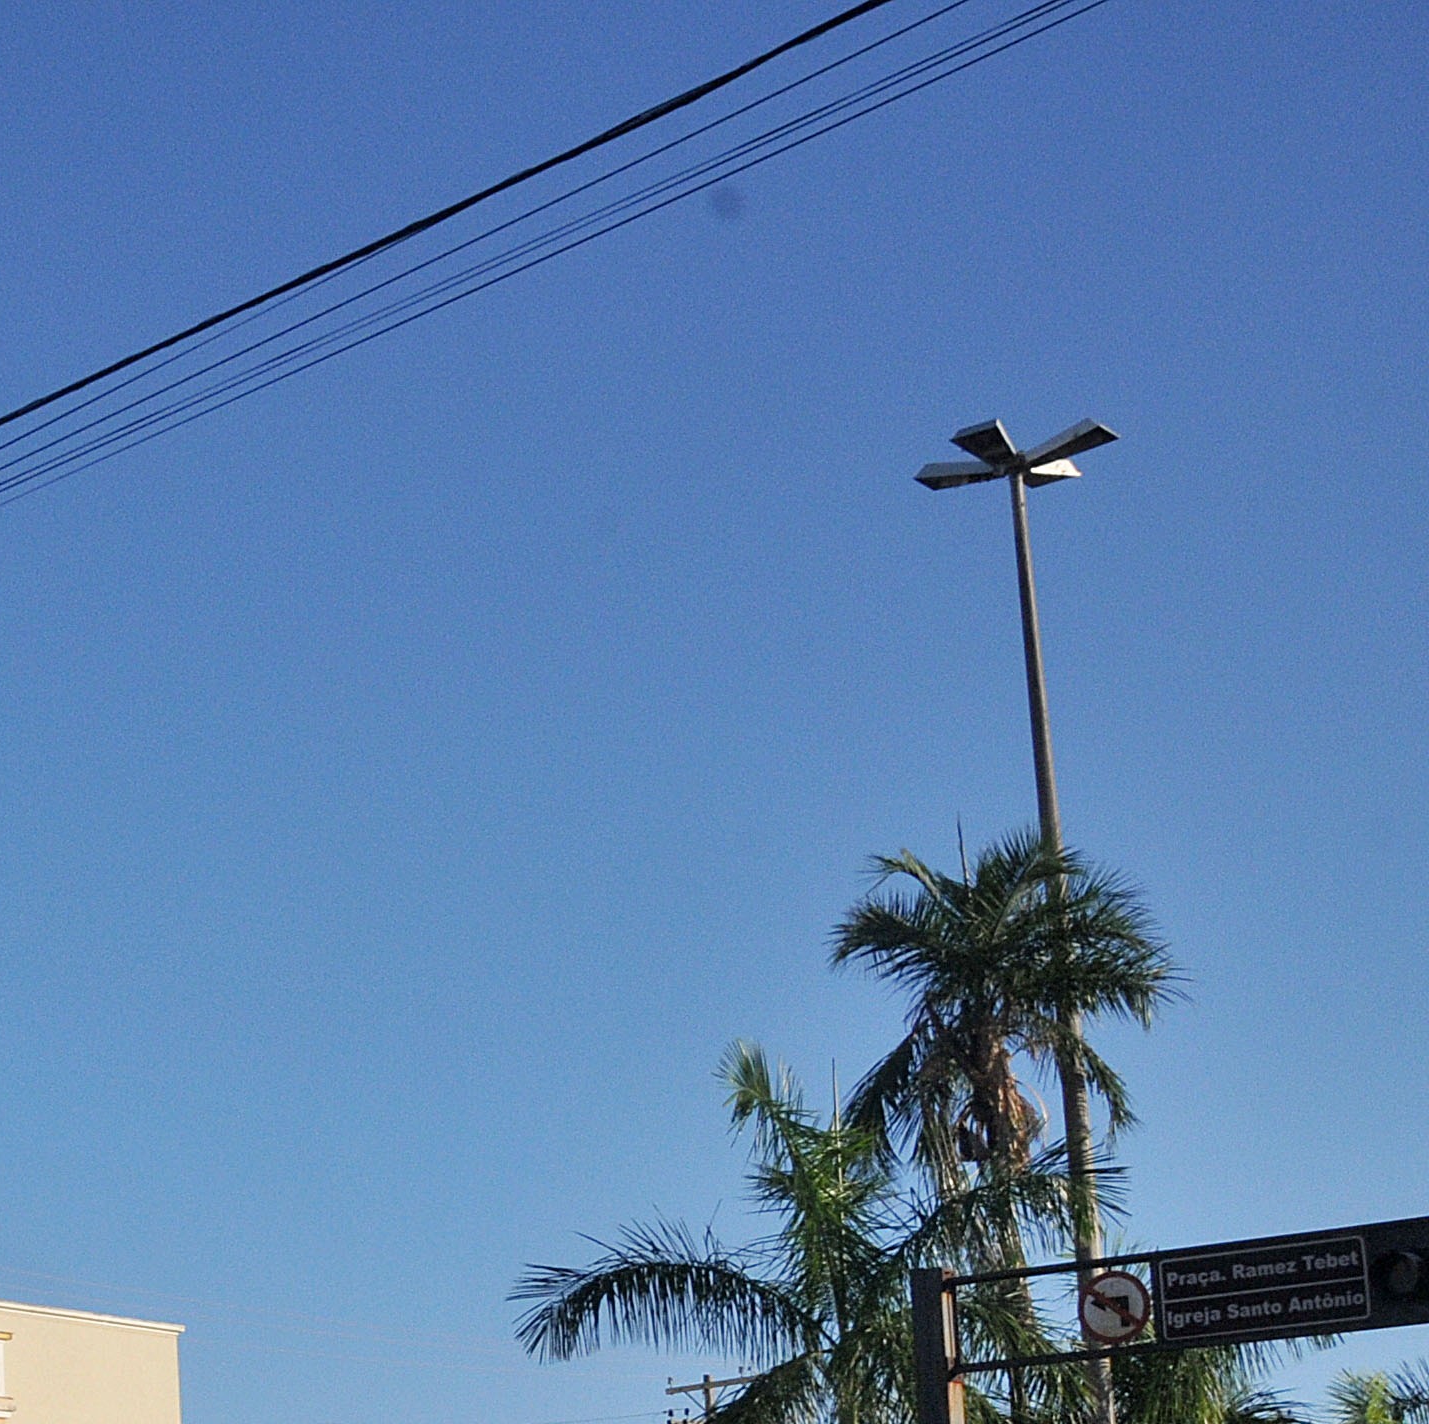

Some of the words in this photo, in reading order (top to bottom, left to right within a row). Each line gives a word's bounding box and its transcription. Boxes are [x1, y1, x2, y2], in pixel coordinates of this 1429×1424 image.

[1167, 1270, 1226, 1287] Praça.
[1233, 1261, 1296, 1279] Ramez
[1302, 1252, 1359, 1270] Tebet
[1168, 1308, 1221, 1328] Igreja
[1227, 1301, 1282, 1319] Santo
[1288, 1291, 1364, 1312] Antônio
